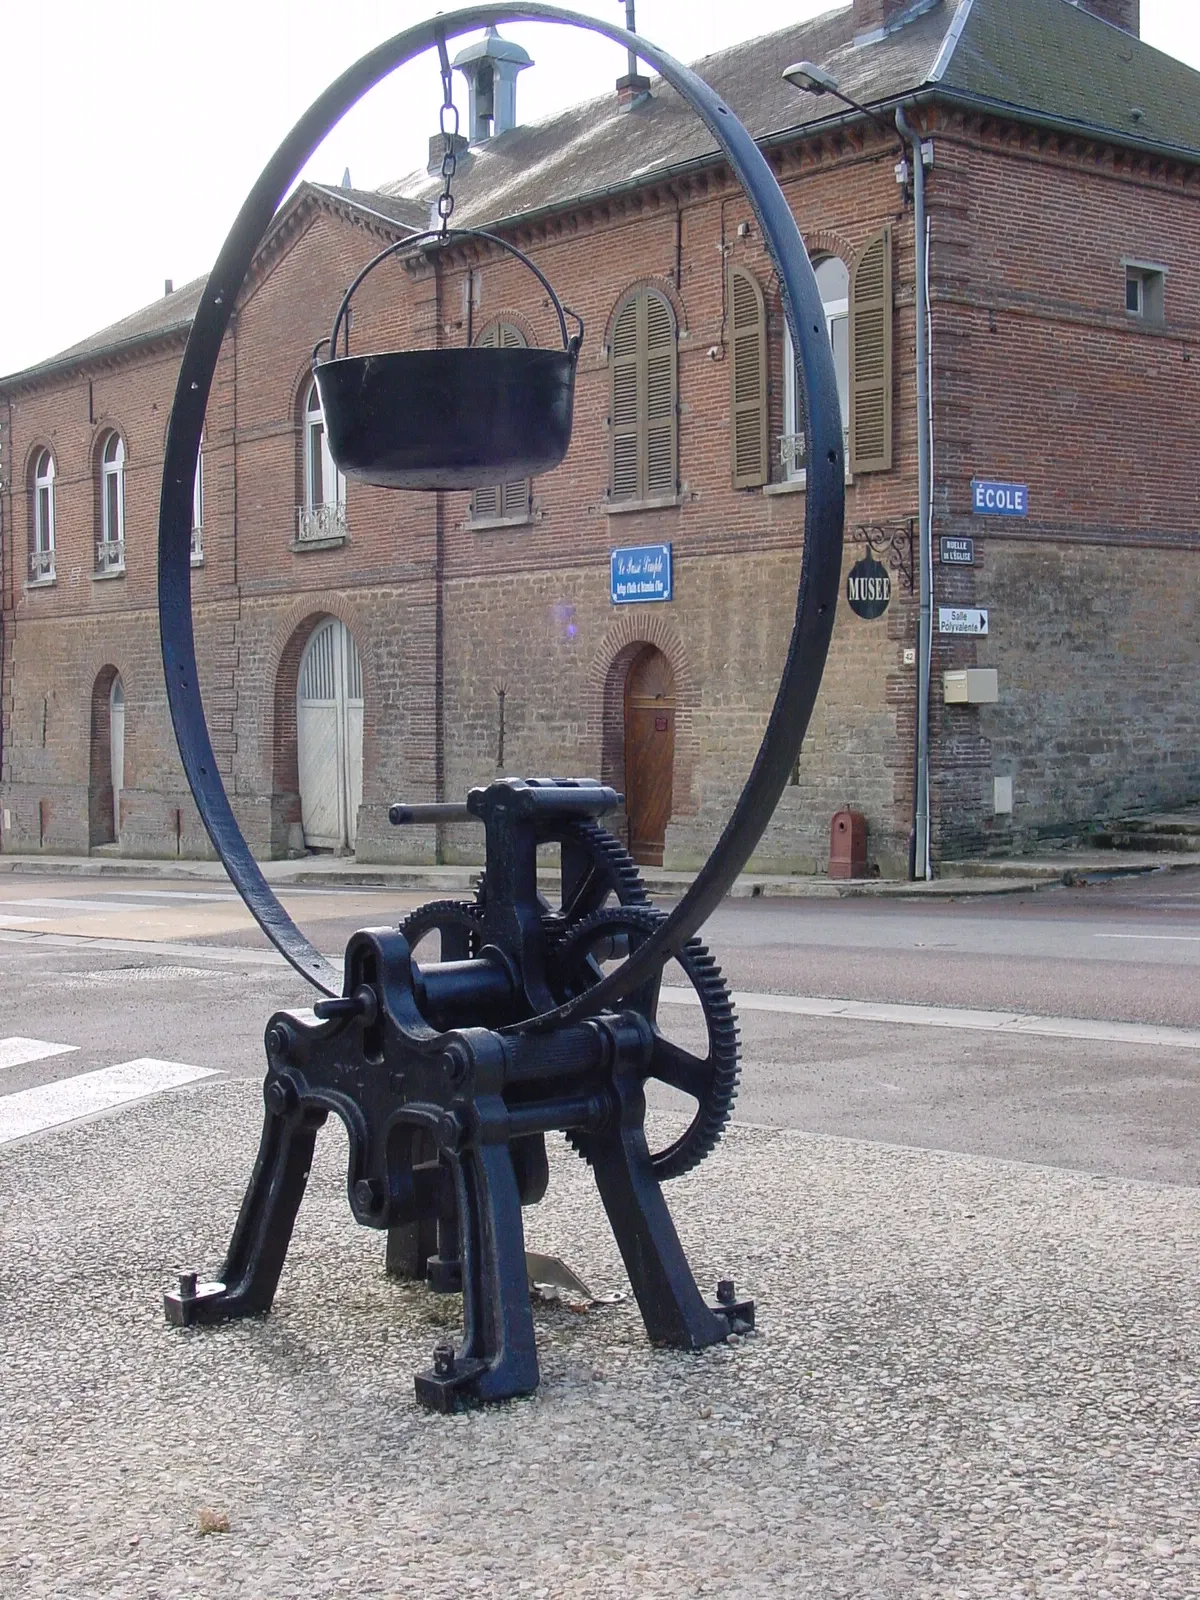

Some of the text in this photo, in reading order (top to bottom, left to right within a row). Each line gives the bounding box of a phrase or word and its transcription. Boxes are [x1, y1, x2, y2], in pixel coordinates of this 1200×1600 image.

[976, 484, 1023, 510] ÉCOLE
[946, 541, 967, 550] RUELLE
[949, 550, 971, 561] L'ÉGLISE
[951, 610, 967, 621] Salle
[941, 621, 978, 633] Polyvalente
[905, 652, 914, 661] 42
